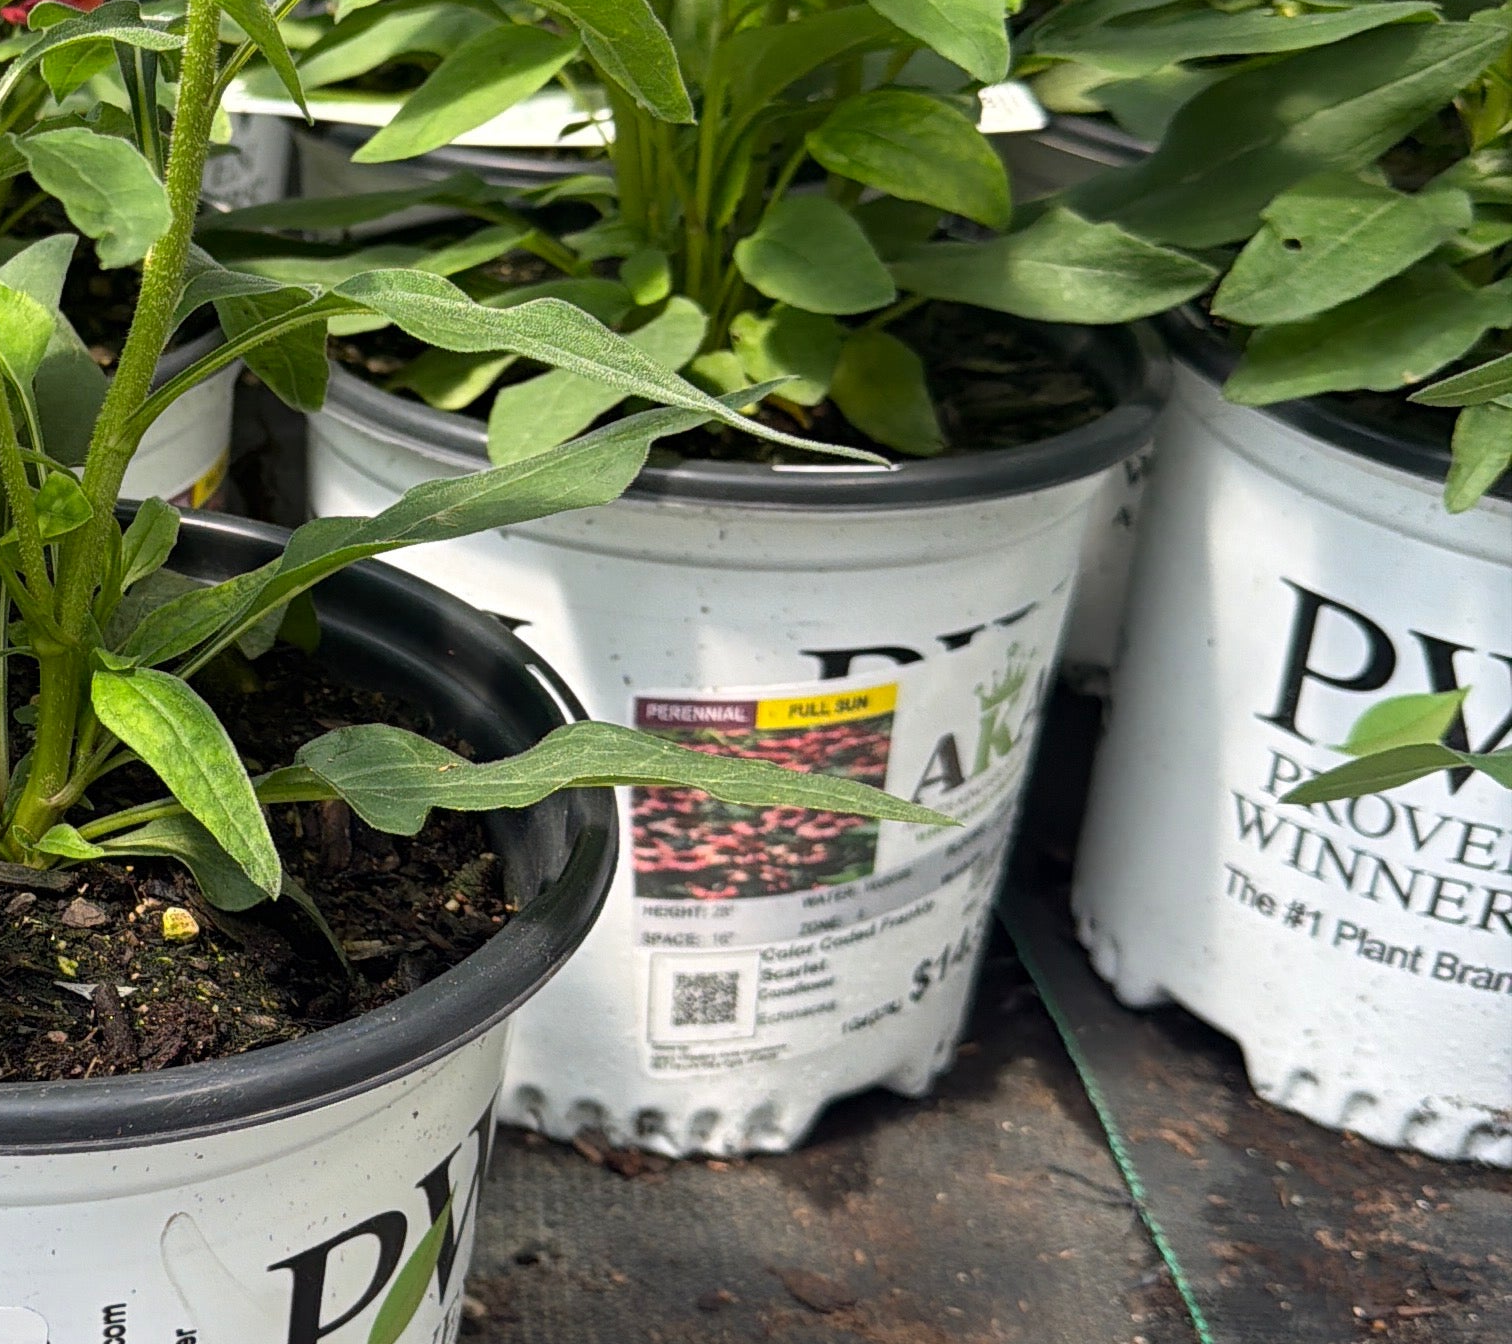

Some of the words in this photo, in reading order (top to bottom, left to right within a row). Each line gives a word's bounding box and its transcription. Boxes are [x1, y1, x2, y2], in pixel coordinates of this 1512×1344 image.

[645, 703, 749, 723] PERENNIAL
[788, 702, 830, 718] FULL
[834, 694, 869, 712] SUN
[1225, 863, 1278, 918] The
[1283, 899, 1322, 938] #1
[1332, 918, 1425, 976] Plant
